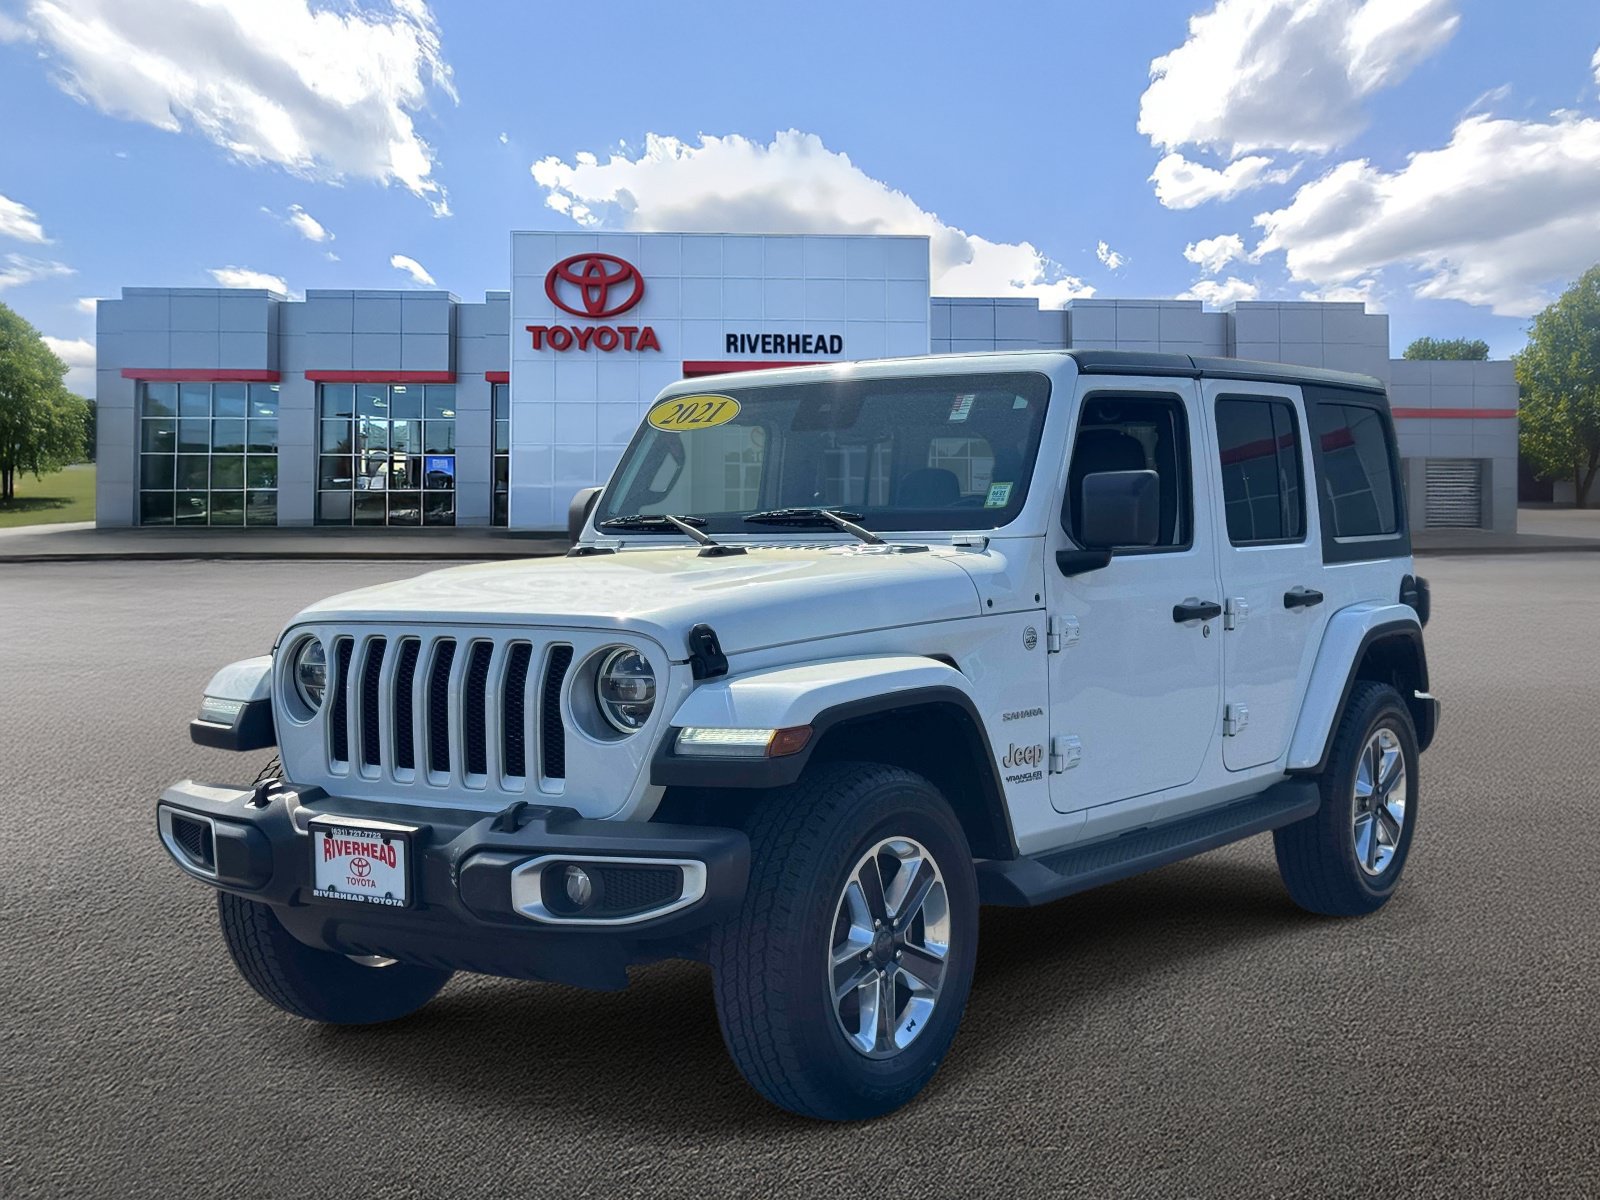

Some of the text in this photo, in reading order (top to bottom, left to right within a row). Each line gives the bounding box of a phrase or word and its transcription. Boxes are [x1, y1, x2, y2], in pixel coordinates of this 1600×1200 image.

[526, 325, 661, 352] TOYOTA
[726, 333, 844, 355] RIVERHEAD
[659, 400, 728, 424] 2021
[1002, 707, 1044, 722] SAHARA
[1002, 742, 1044, 768] Jeep
[1005, 770, 1043, 782] WRANGLER
[323, 838, 397, 869] RIVERHEAD
[346, 876, 376, 888] TOYOTA
[313, 889, 404, 907] RIVERHEAD TOYOTA
